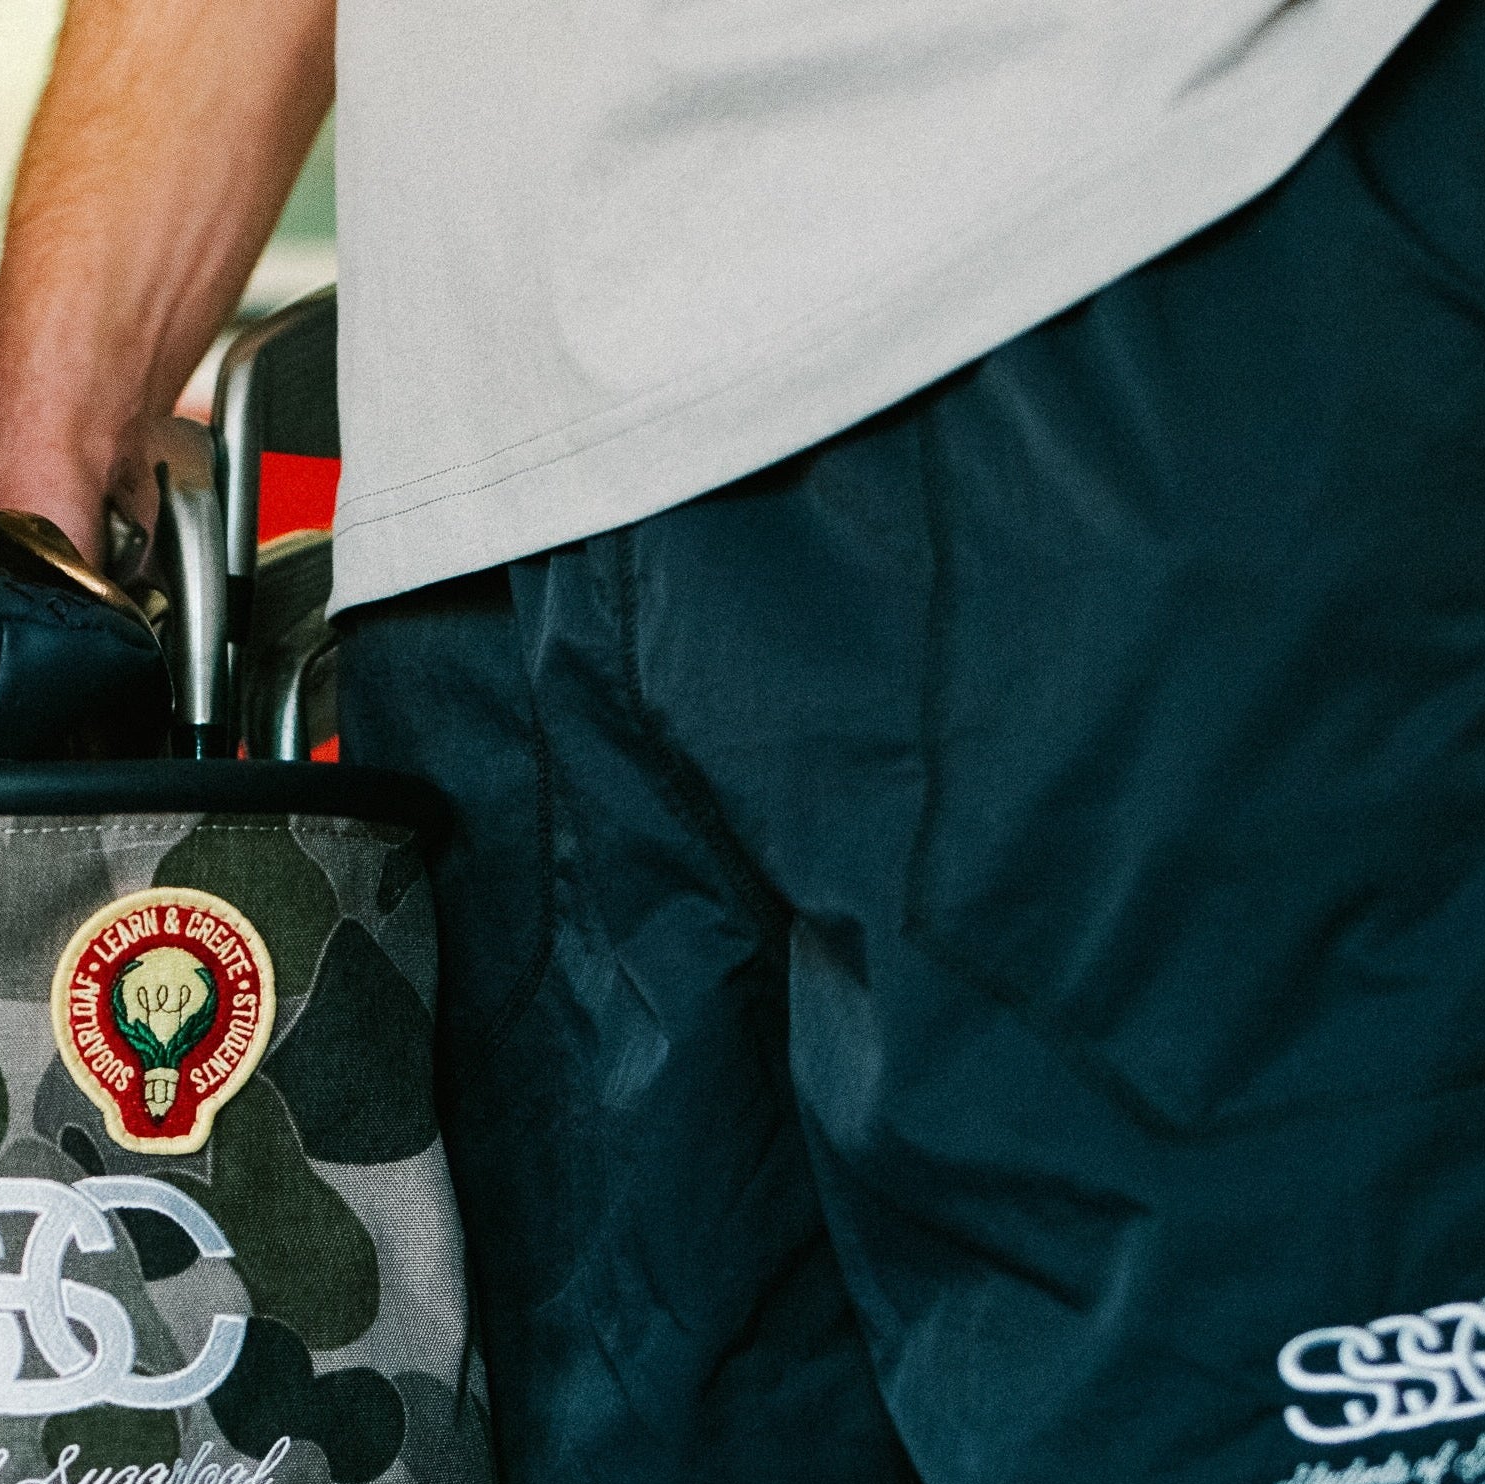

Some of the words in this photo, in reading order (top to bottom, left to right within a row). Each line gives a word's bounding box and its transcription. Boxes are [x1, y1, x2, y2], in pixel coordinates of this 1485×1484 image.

[93, 909, 158, 963] LEARN
[164, 907, 180, 934] &
[185, 912, 251, 980] CREATE
[190, 992, 257, 1094] STUDENTS
